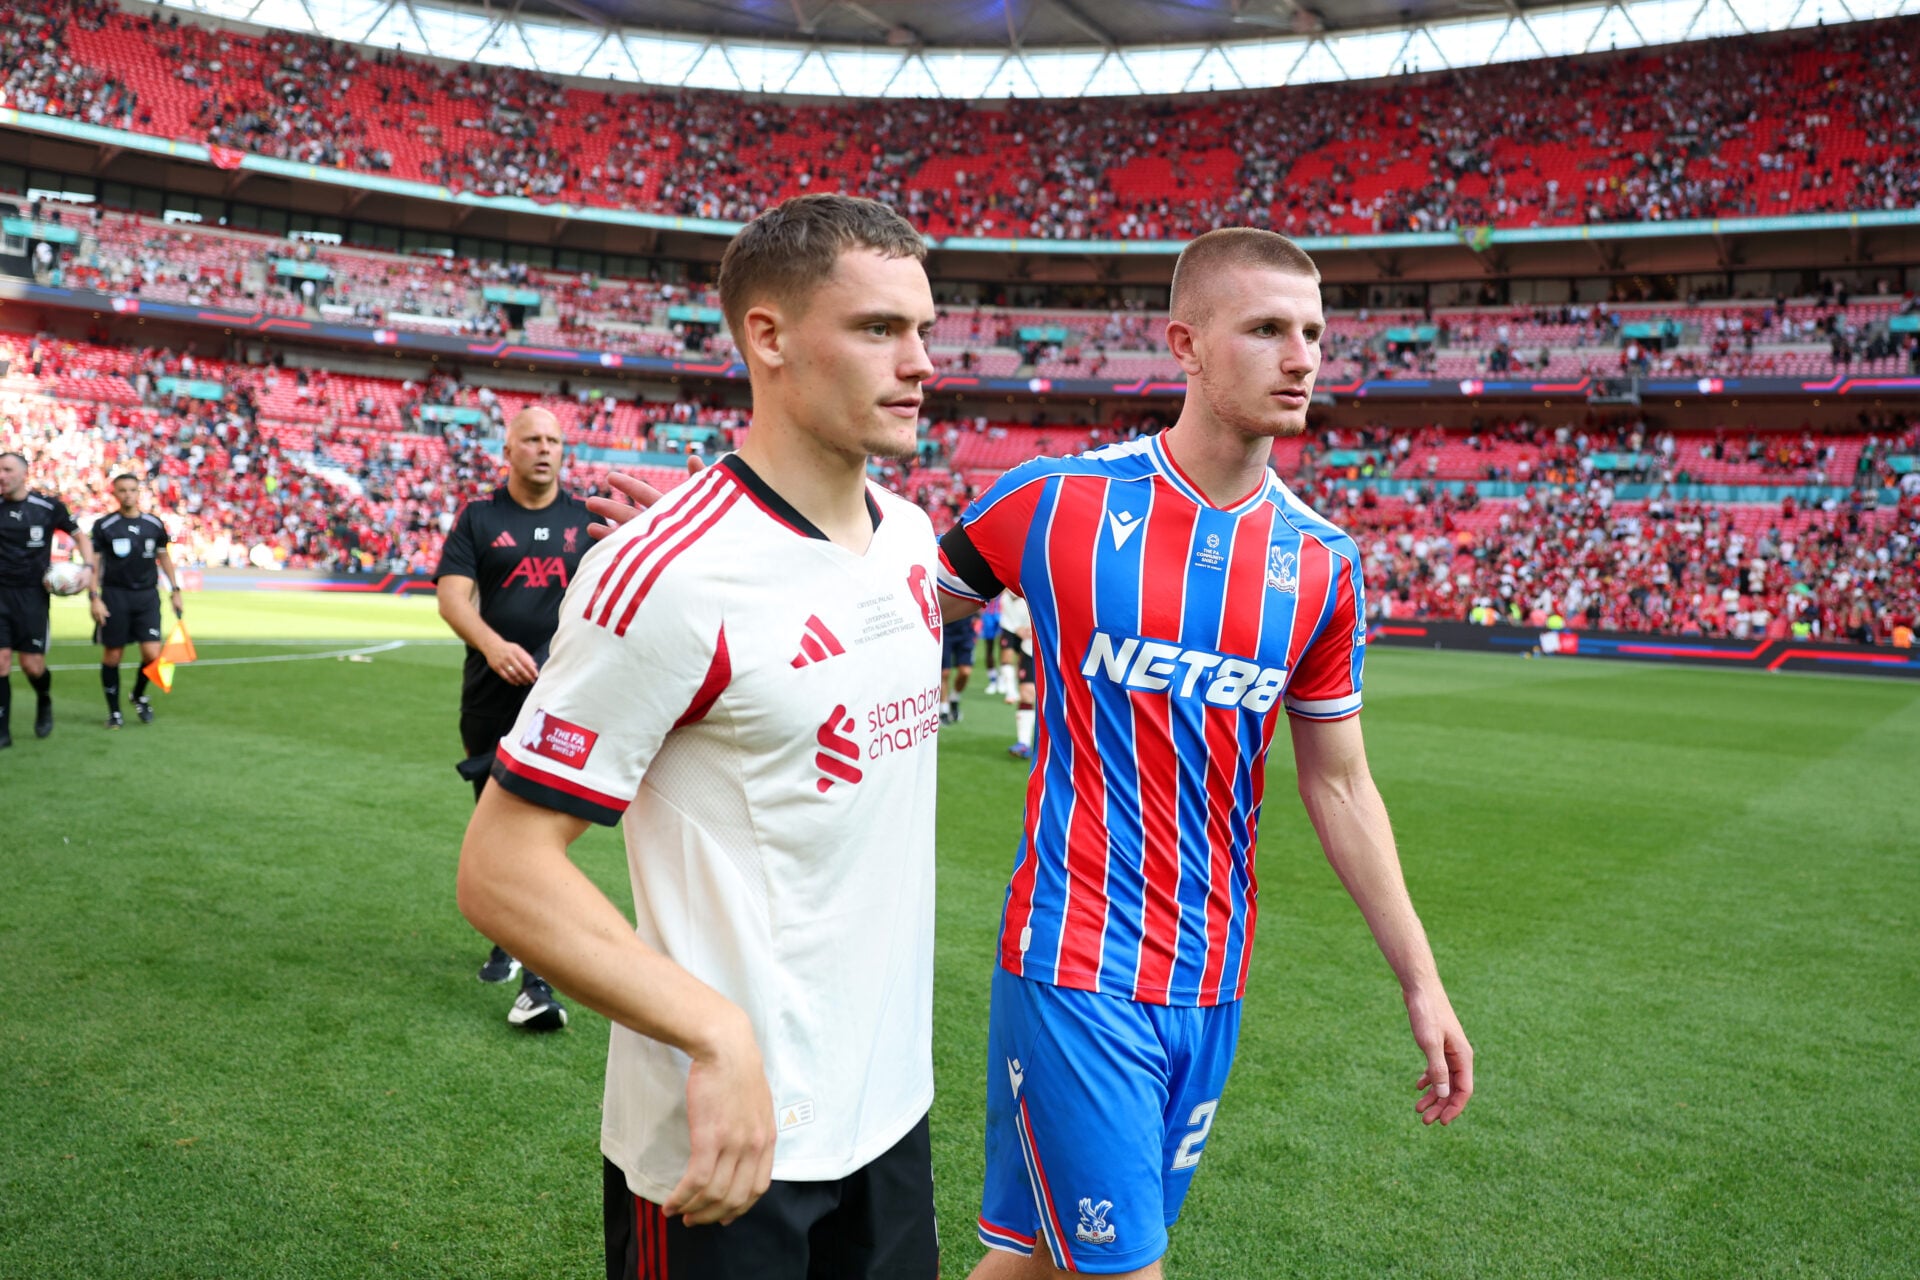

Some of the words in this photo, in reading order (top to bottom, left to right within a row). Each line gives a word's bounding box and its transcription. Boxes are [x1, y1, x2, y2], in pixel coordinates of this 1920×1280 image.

[501, 556, 568, 588] AXA
[1081, 631, 1289, 713] NET88
[554, 727, 571, 741] THE
[571, 733, 585, 746] FA
[1170, 1098, 1218, 1171] 2
